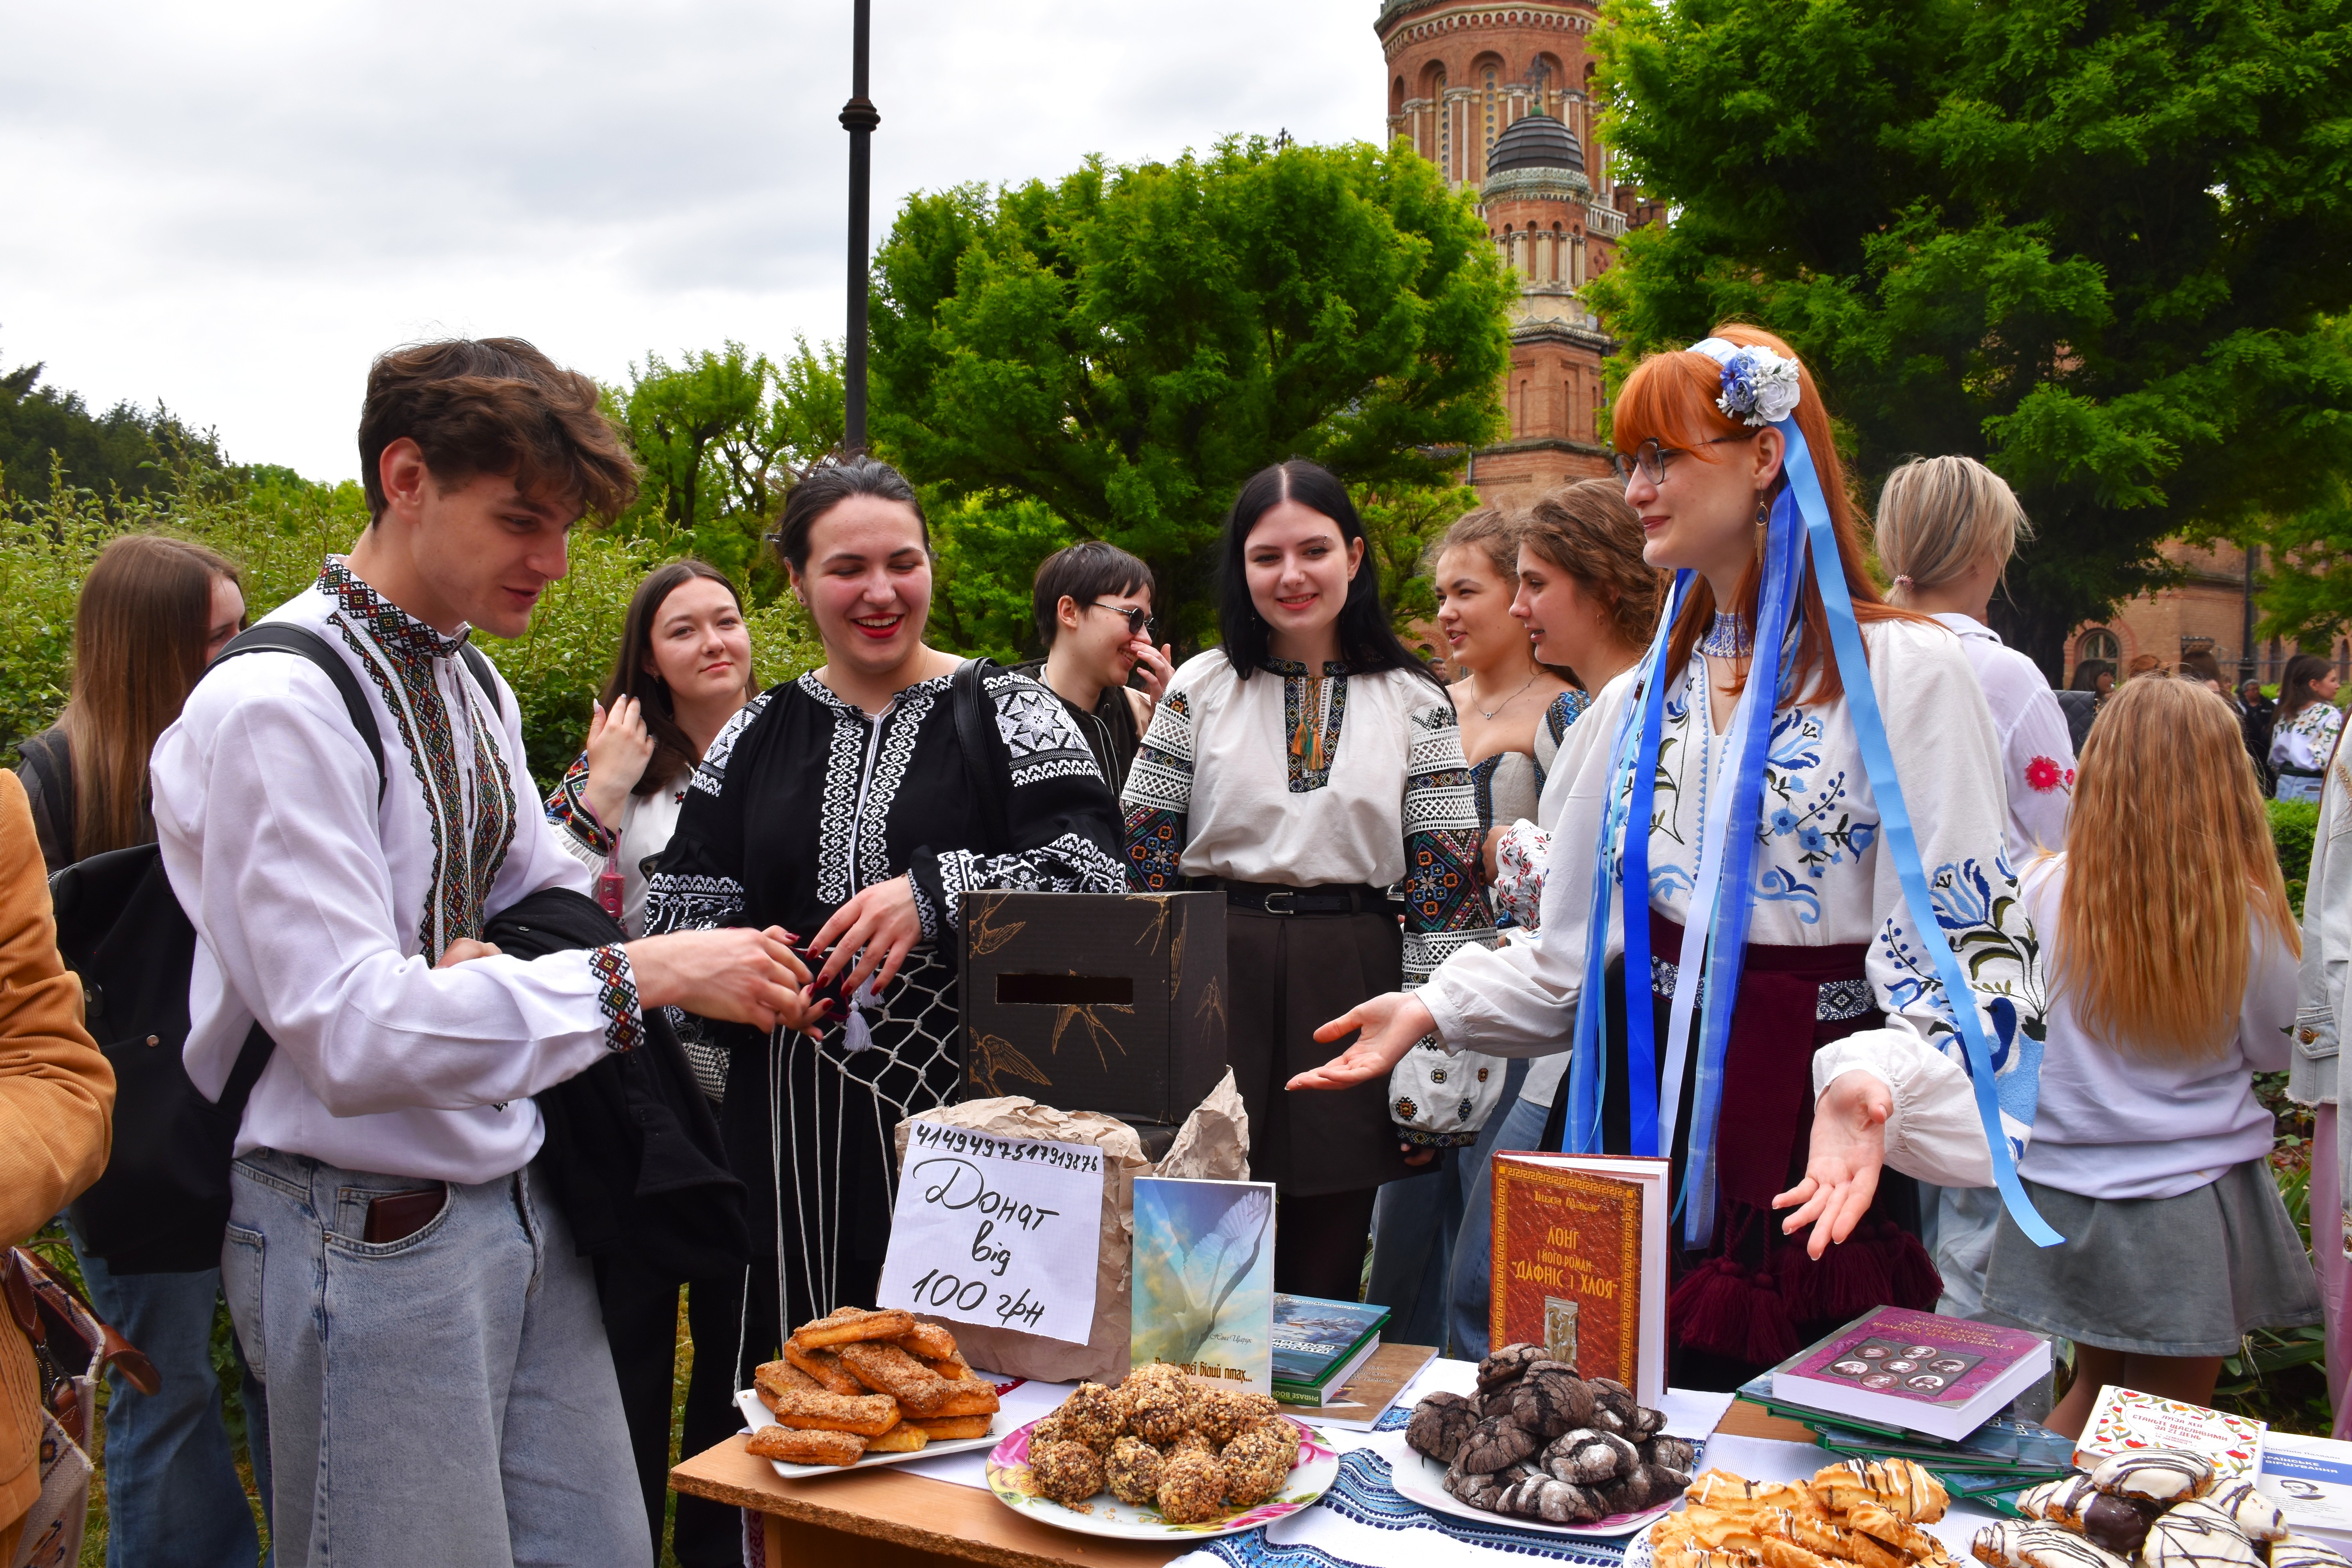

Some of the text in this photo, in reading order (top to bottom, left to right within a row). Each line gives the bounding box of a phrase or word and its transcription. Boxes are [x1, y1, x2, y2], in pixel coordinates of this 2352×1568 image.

[916, 1124, 1098, 1172] 4149497517919876
[913, 1157, 1060, 1230] Донат
[1566, 1197, 1599, 1212] Макар
[1547, 1226, 1579, 1249] ЛОНГ
[972, 1220, 1011, 1276] від
[1542, 1249, 1562, 1266] ЙОГО
[1564, 1255, 1591, 1273] РОМАН
[912, 1269, 1045, 1328] 100 грн
[1291, 1345, 1329, 1354] хата
[1292, 1393, 1319, 1401] PHRASE
[1815, 1425, 1828, 1434] ичук
[2132, 1414, 2228, 1441] СТАНЬТЕ ЩАСЛИВИМИ
[2178, 1431, 2201, 1440] ДЕНЬ
[2263, 1455, 2319, 1466] КРАЇНСЬКЕ
[2265, 1460, 2338, 1474] ВІРШУВАННЯ
[1937, 1477, 1945, 1487] Не
[1987, 1497, 1997, 1507] Не
